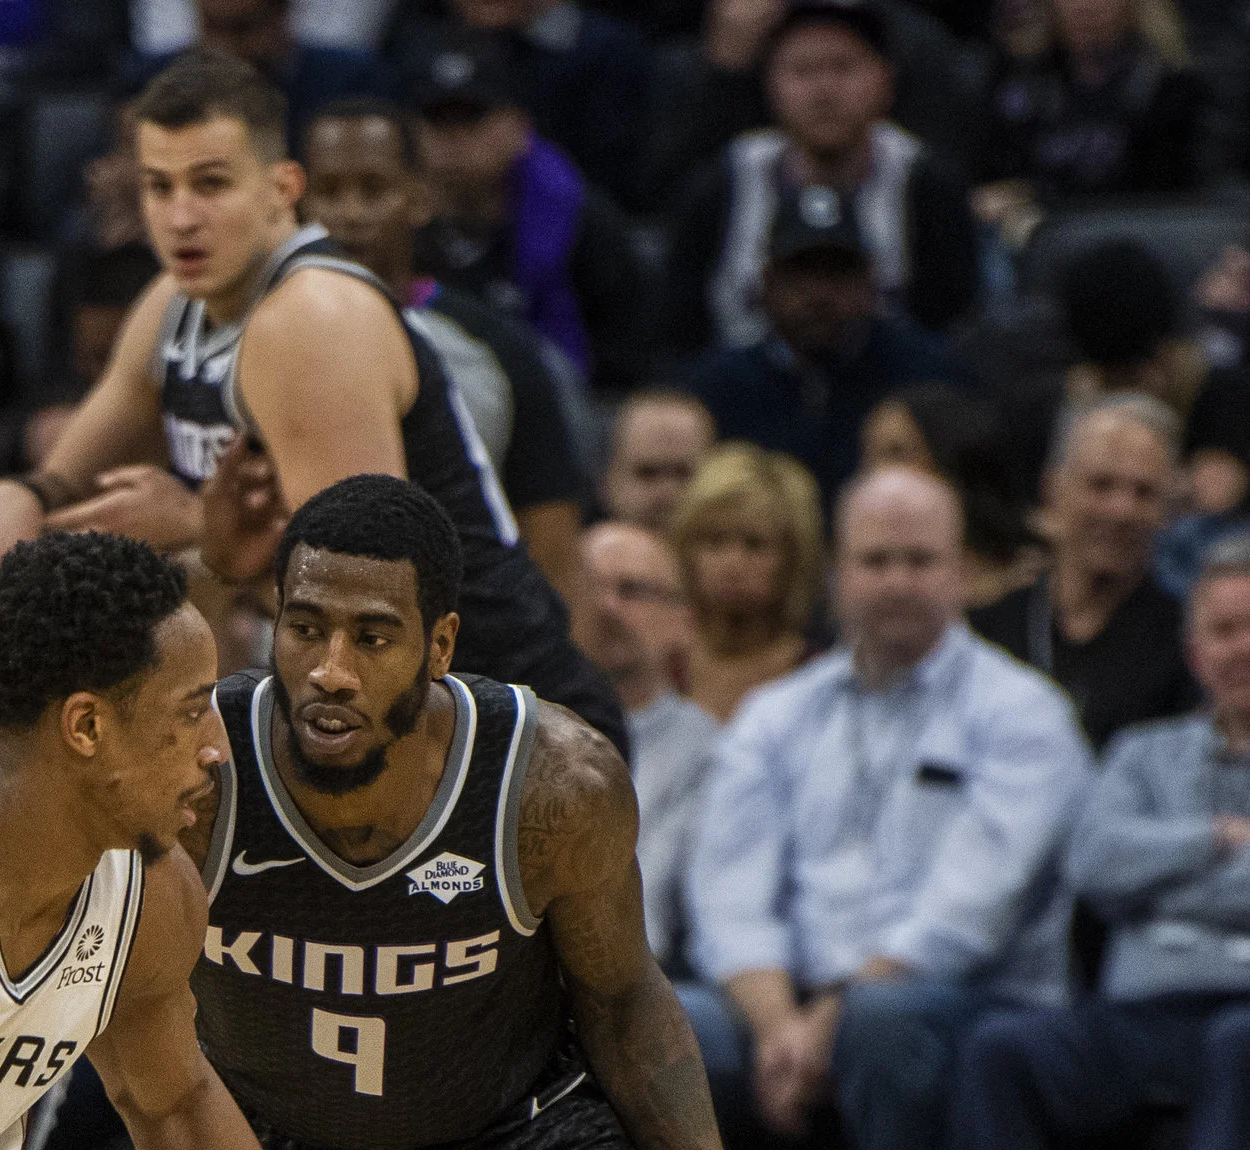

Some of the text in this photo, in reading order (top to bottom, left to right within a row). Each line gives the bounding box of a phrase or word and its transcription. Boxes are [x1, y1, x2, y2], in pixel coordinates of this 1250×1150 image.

[425, 866, 469, 879] DIAMOND
[436, 861, 458, 871] BLUE
[411, 880, 481, 892] ALMONDS
[203, 925, 500, 996] KINGS
[56, 962, 106, 990] Frost
[311, 1006, 387, 1097] 9
